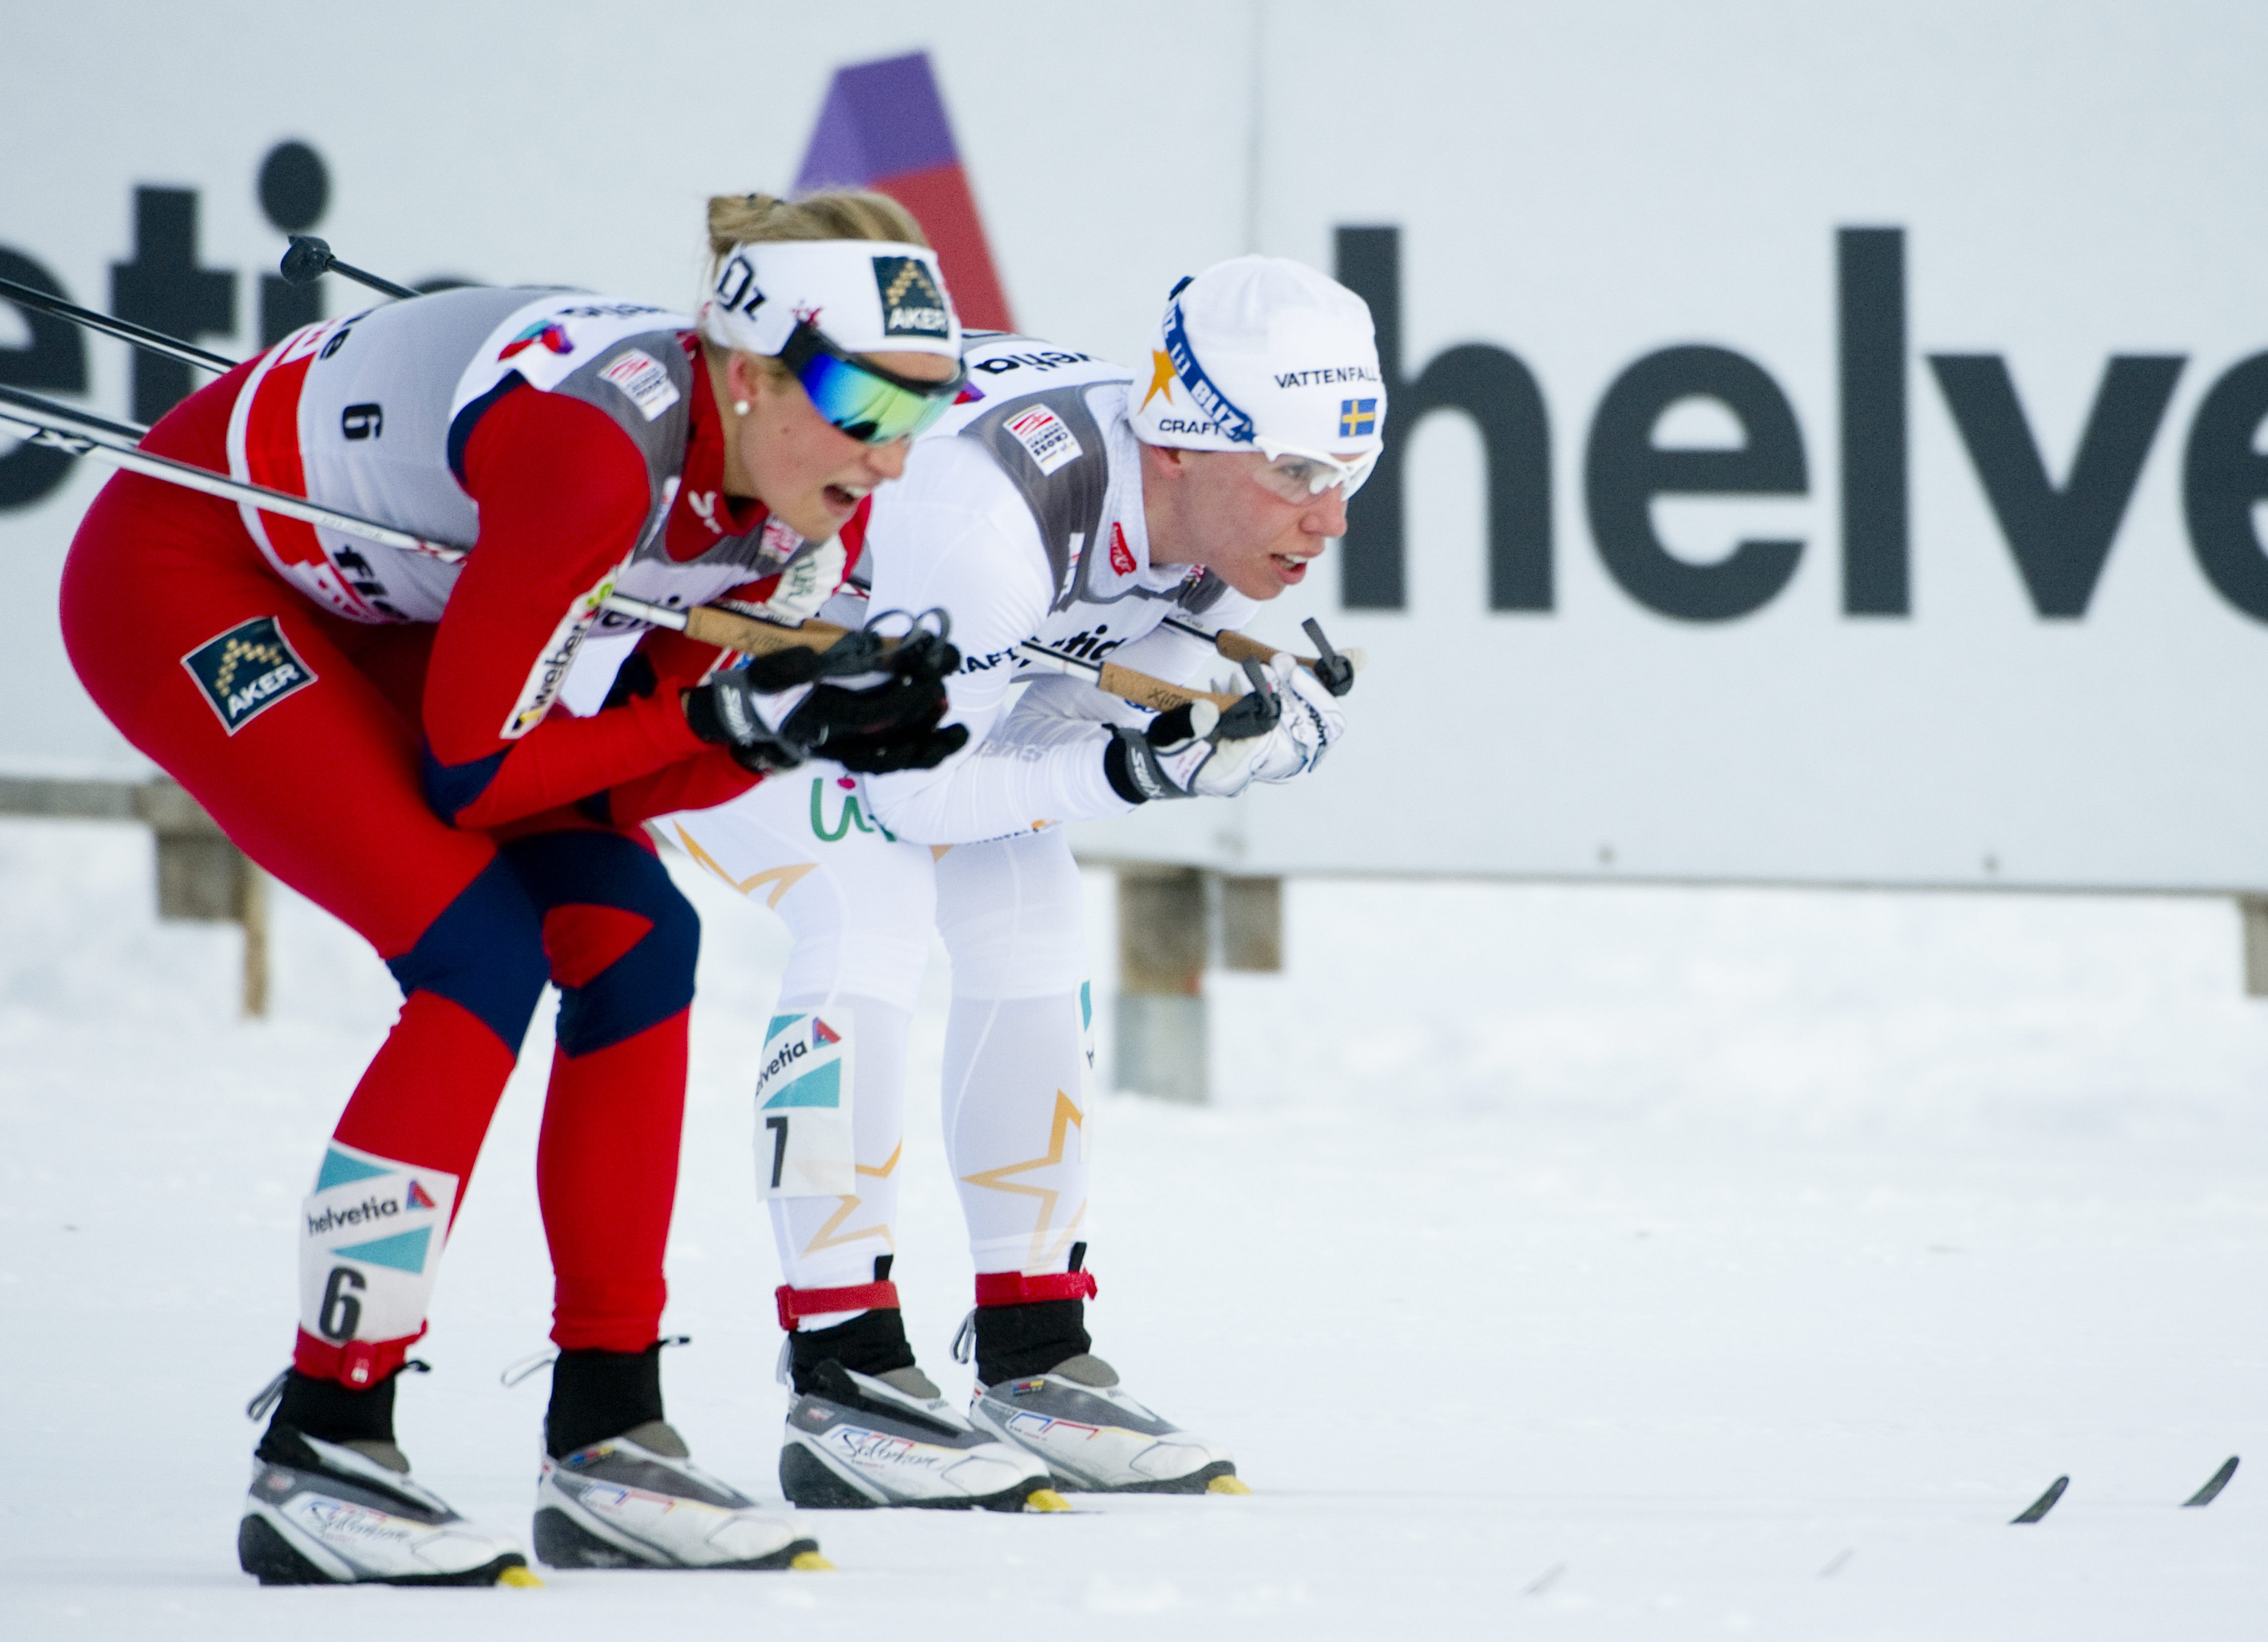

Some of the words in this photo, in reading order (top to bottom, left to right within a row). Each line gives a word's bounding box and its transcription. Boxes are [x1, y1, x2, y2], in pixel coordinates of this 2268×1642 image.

[888, 306, 947, 331] AKER
[1274, 367, 1378, 389] VATTENFALL
[341, 402, 383, 441] 6
[1159, 419, 1220, 435] CRAFT
[1191, 379, 1246, 438] BLIZ
[531, 622, 586, 711] weber
[227, 663, 300, 719] AKER
[766, 1115, 788, 1189] 7
[307, 1195, 399, 1236] helvetia
[319, 1265, 367, 1341] 6
